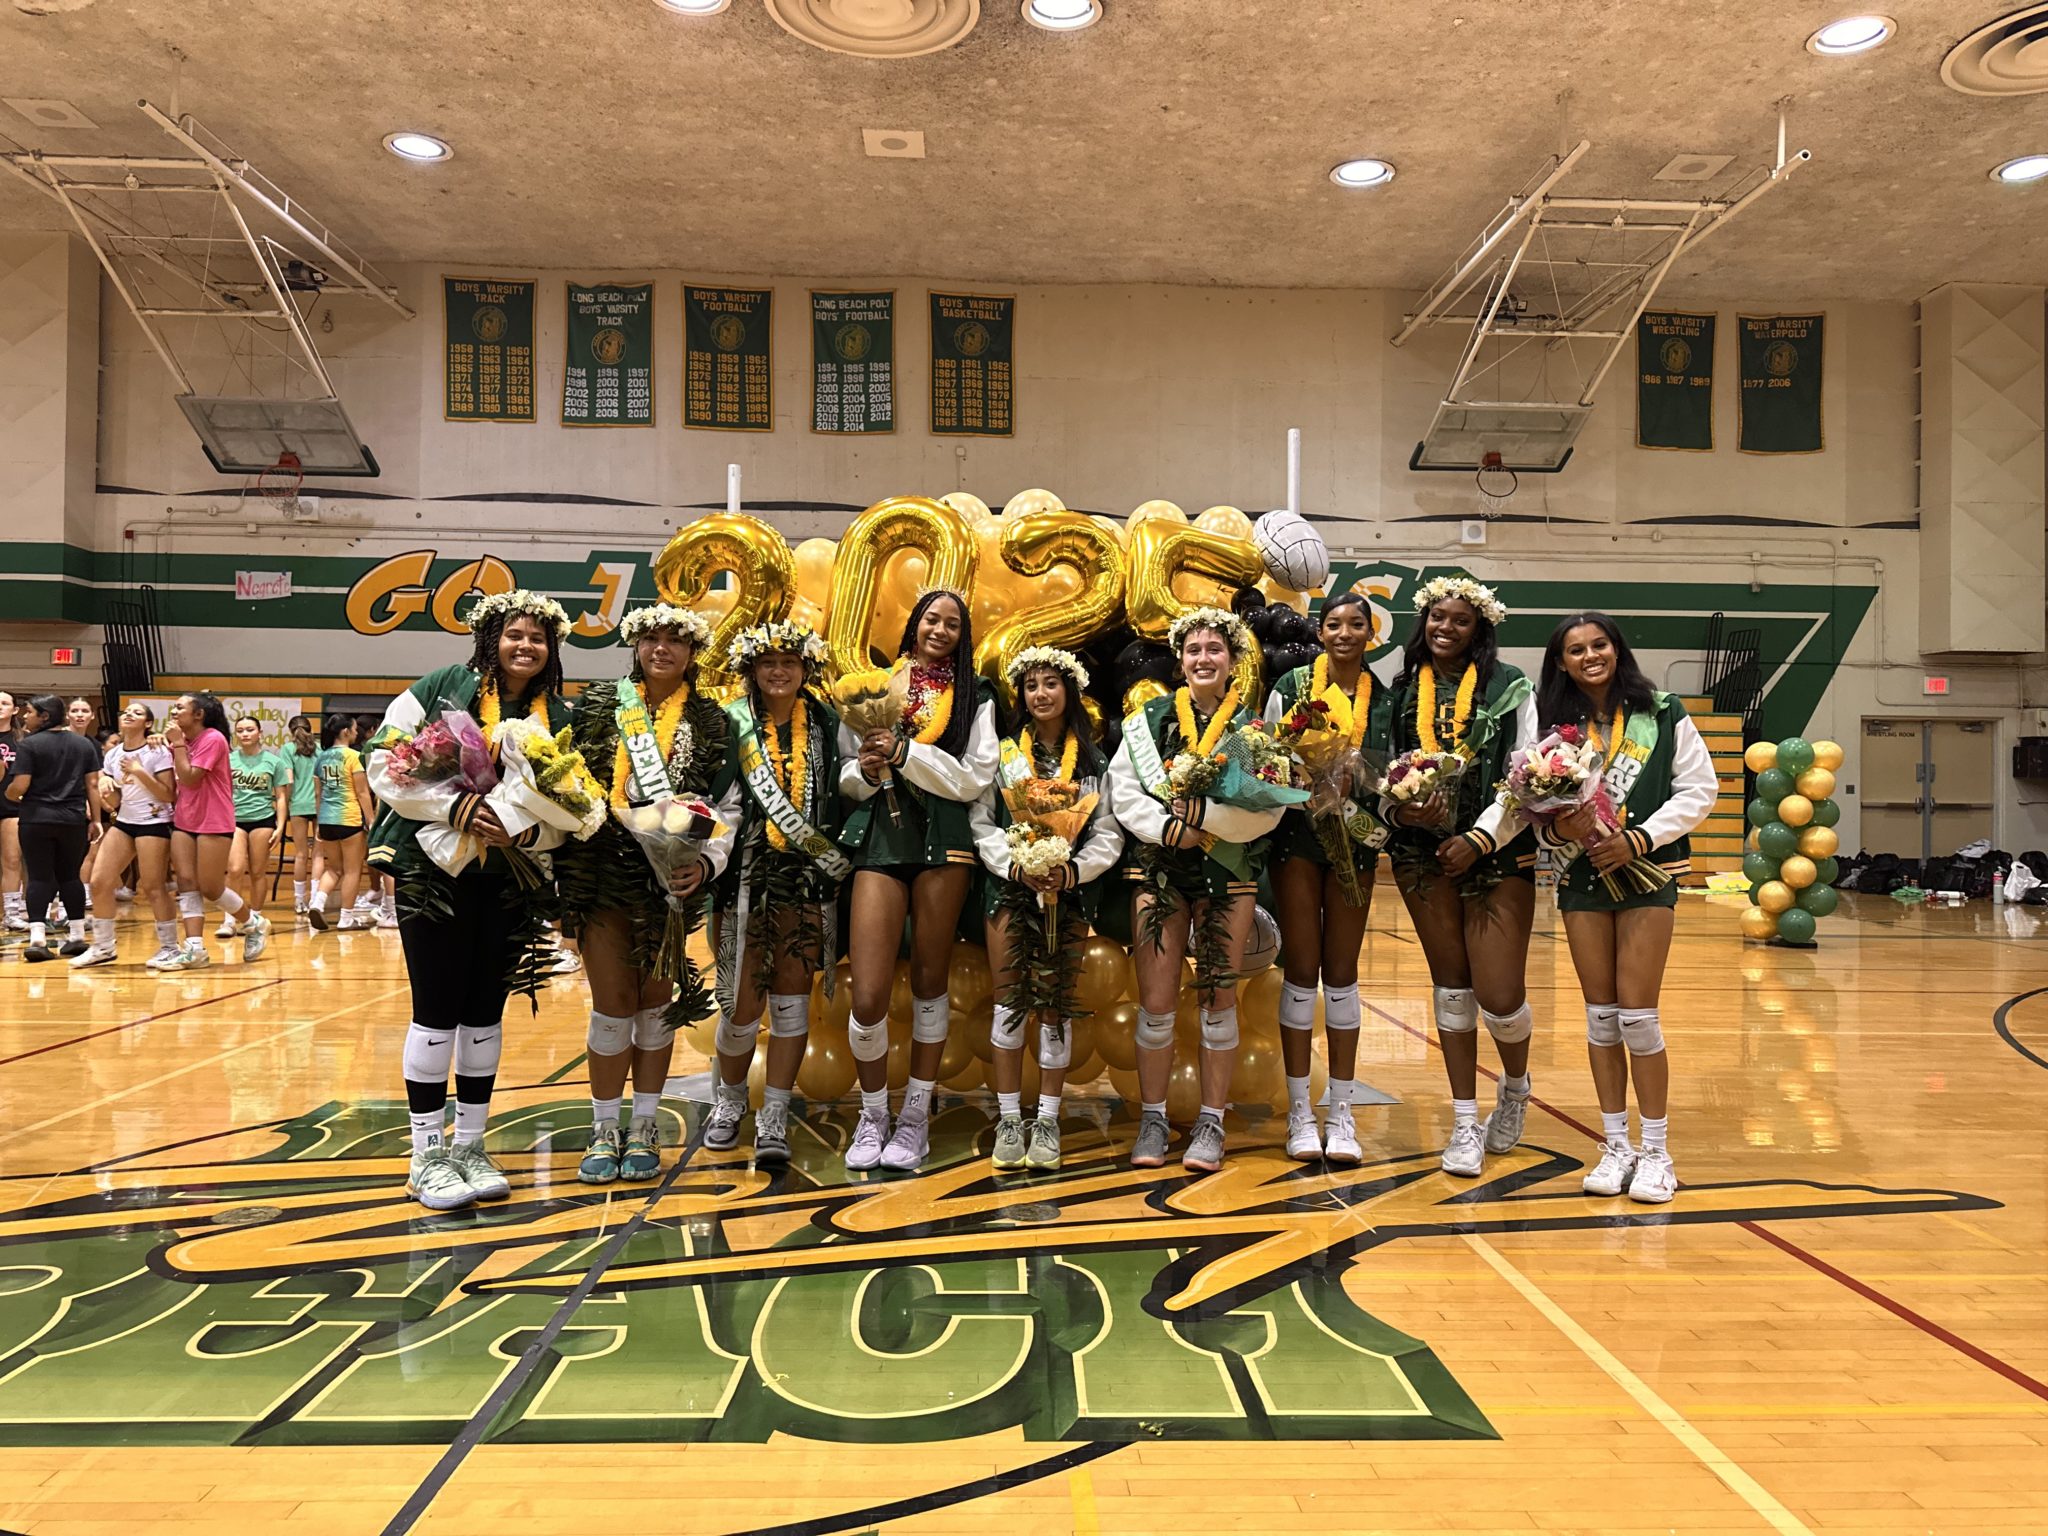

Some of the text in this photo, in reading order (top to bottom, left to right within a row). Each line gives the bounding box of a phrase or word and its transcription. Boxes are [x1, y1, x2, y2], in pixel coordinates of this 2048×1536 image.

[455, 283, 524, 295] BOYS VARSITY
[474, 293, 505, 303] TRACK
[572, 293, 594, 303] LONG
[597, 293, 622, 302] BEACH
[693, 291, 761, 304] BOYS VARSITY
[607, 304, 639, 314] VARSITY
[704, 302, 752, 312] FOOTBALL
[814, 299, 890, 309] LONG BEACH POLY
[939, 298, 1004, 310] BOYS VARSITY
[846, 311, 890, 320] FOOTBALL
[943, 308, 1002, 320] BASKETBALL
[597, 316, 623, 326] TRACK
[1646, 316, 1705, 327] BOYS VARSITY
[1747, 320, 1814, 330] BOYS VARSITY
[1653, 326, 1700, 336] WRESTLING
[628, 368, 648, 377] 1997
[818, 373, 837, 382] 1997
[870, 373, 890, 382] 1999
[597, 378, 619, 387] 2000
[628, 378, 648, 387] 2001
[1768, 378, 1792, 388] 2006
[566, 387, 649, 398] 2002 2003 2004
[817, 383, 890, 393] 2000 2001 2002
[565, 398, 649, 408] 2005 2006 2007
[817, 393, 891, 403] 2003 2004 2005
[596, 408, 619, 417] 2009
[627, 409, 649, 418] 2010
[817, 404, 839, 413] 2006
[843, 404, 865, 413] 2007
[817, 412, 891, 422] 2010 2011 2012
[817, 422, 864, 431] 2013 2014
[346, 549, 517, 635] GO
[1124, 712, 1167, 793] SENIOR
[322, 764, 340, 786] 14
[748, 764, 815, 845] SENIOR
